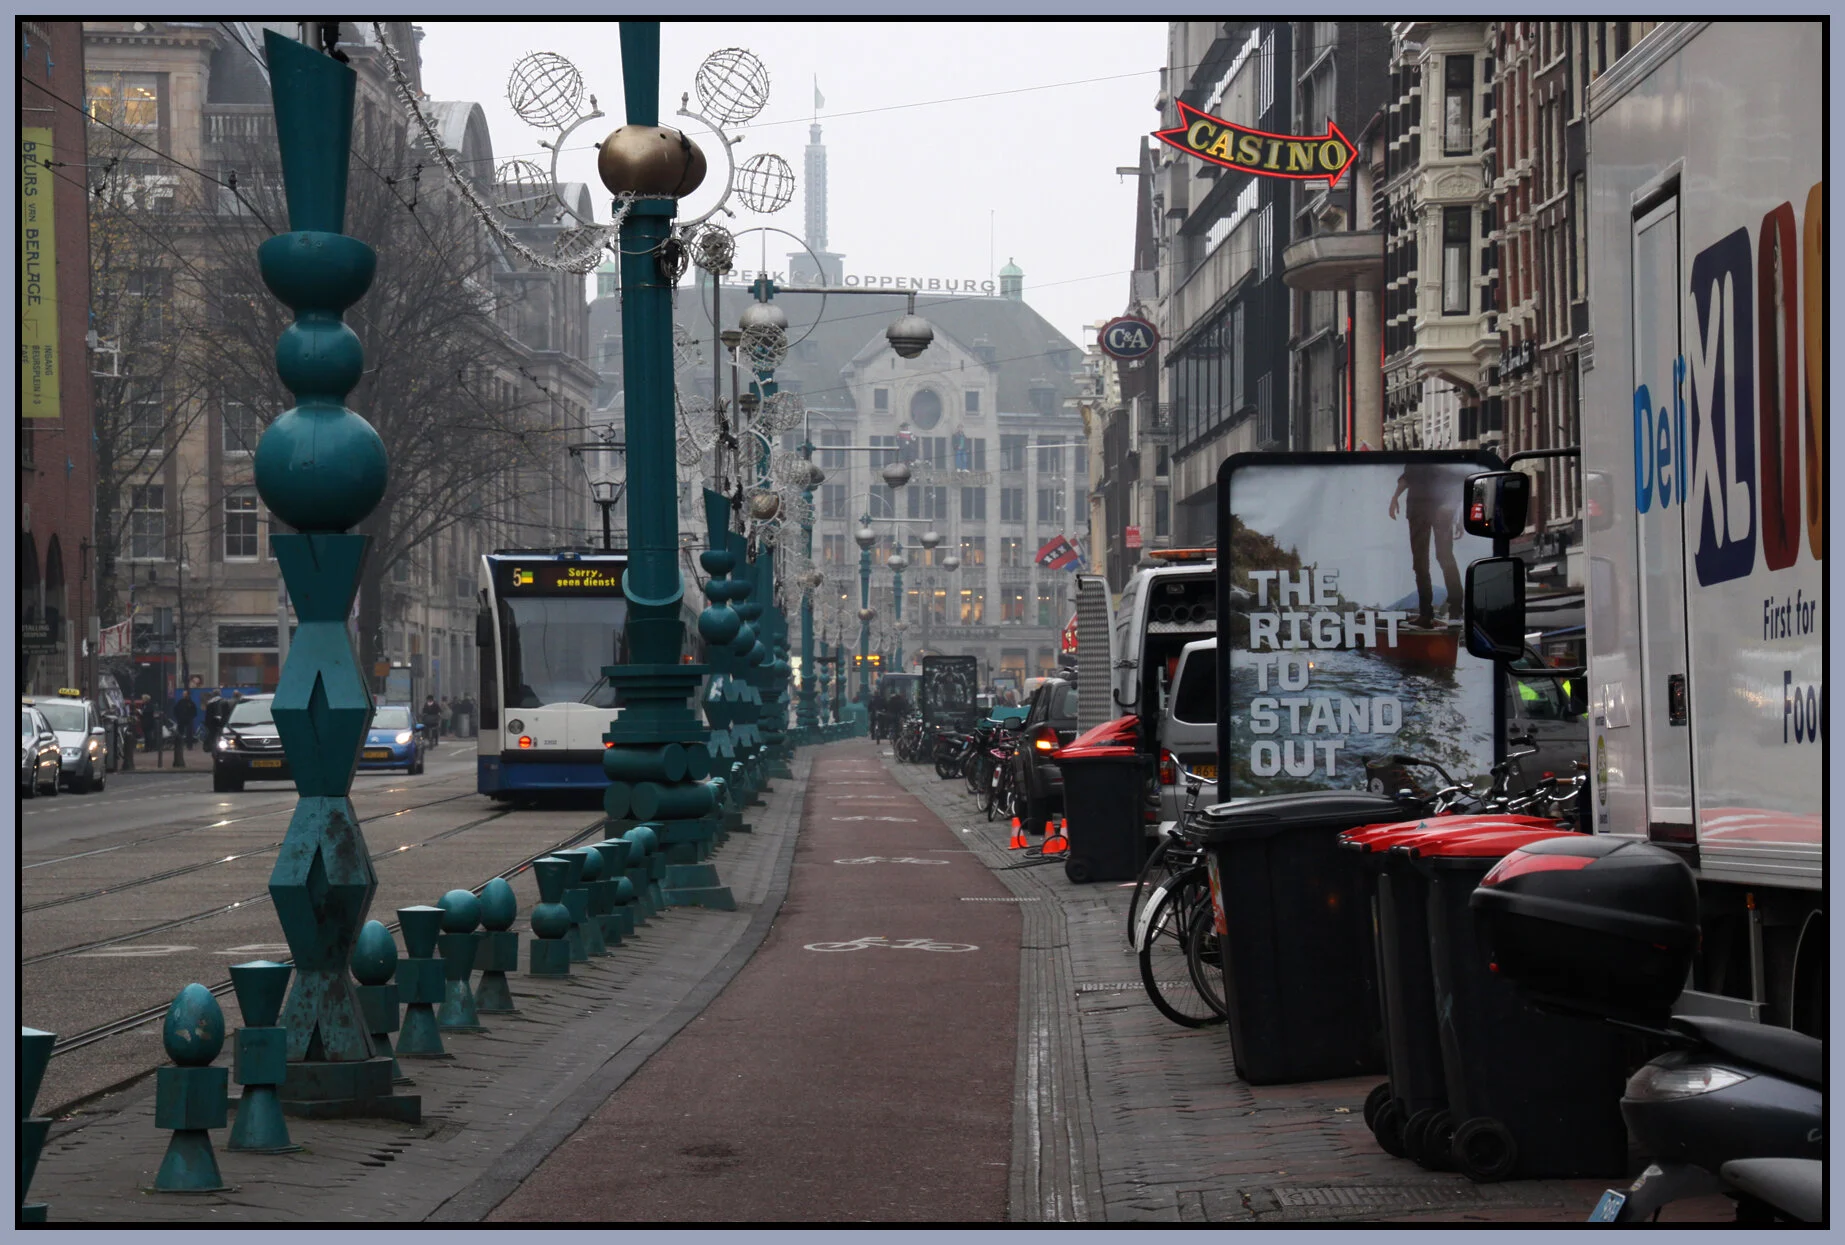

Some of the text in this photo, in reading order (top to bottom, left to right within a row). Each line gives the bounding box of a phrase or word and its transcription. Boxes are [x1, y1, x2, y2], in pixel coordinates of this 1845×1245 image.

[1187, 119, 1349, 173] CASINO
[22, 142, 38, 197] BEURS
[26, 229, 41, 306] BERLAGE
[1108, 327, 1149, 350] C&A
[512, 567, 522, 588] 5
[556, 577, 616, 588] geen dienst
[567, 567, 603, 579] Sorry,
[1248, 568, 1340, 607] THE
[1249, 610, 1407, 650] RIGHT
[1764, 589, 1816, 641] First for
[1250, 656, 1310, 692] TO
[1249, 697, 1404, 734] STAND
[1783, 670, 1822, 745] Foo
[1250, 739, 1346, 778] OUT
